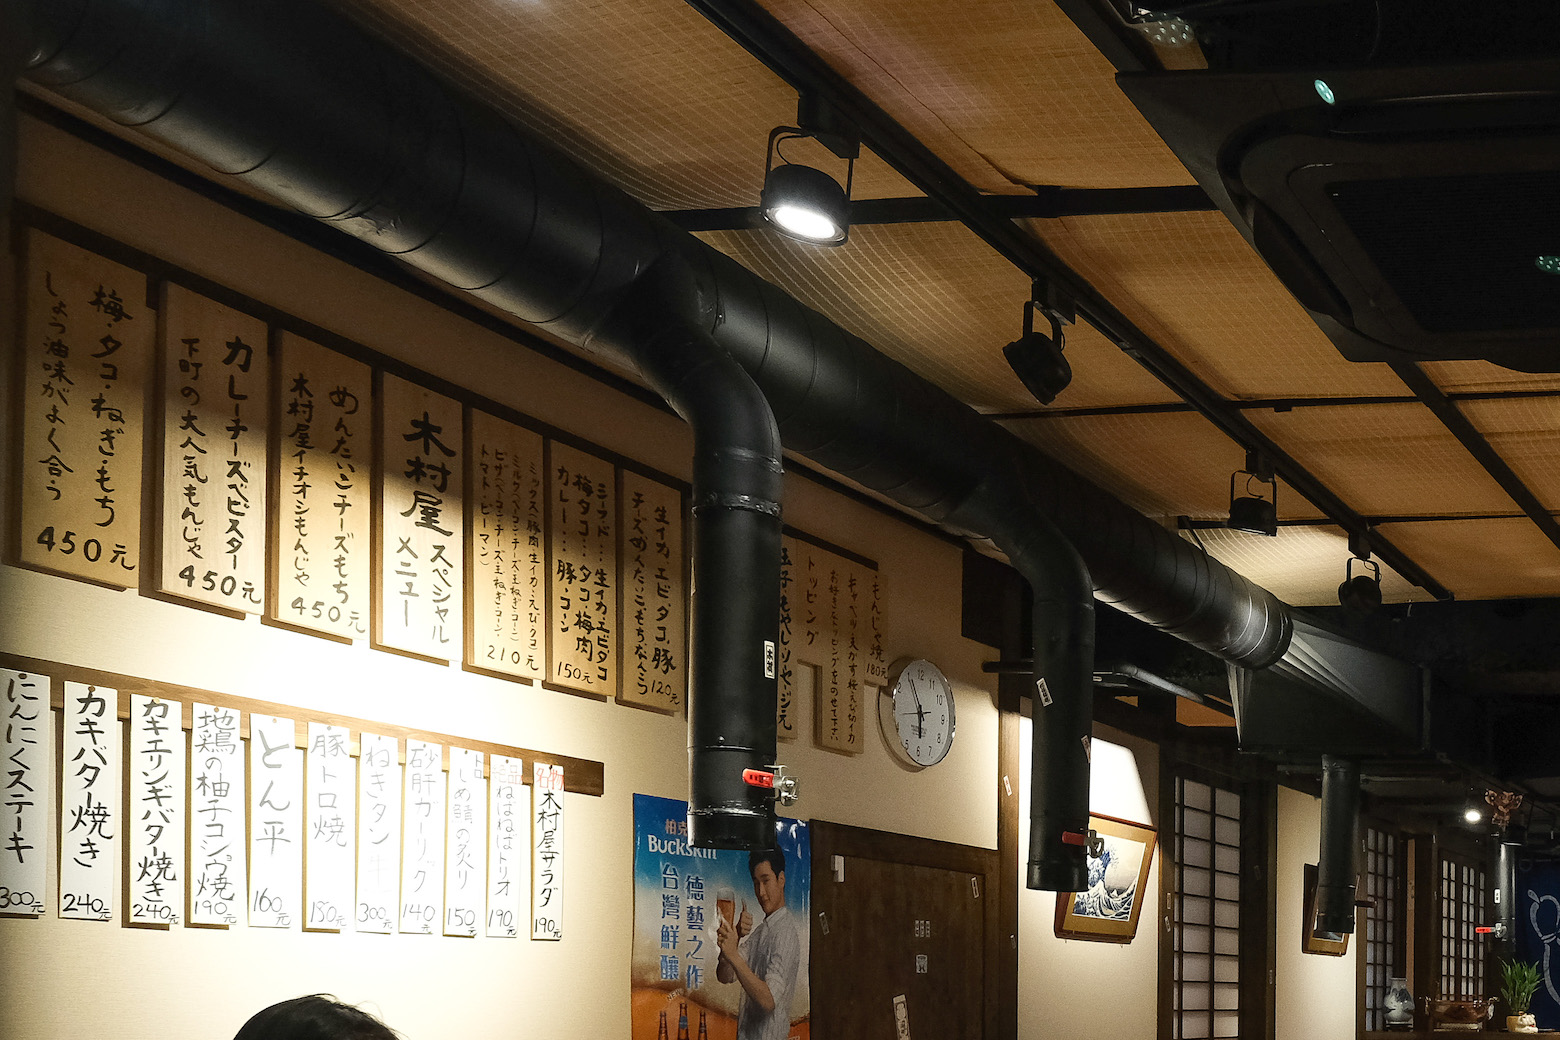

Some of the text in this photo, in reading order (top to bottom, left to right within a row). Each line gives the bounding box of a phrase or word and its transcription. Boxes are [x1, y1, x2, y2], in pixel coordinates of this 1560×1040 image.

[38, 270, 74, 500] しょう油味がよく合う
[178, 338, 208, 560] 下町の大人気もんじゃ
[287, 372, 315, 587] 木村屋イチオシもんじゃ
[328, 385, 359, 604] めんたいこチーズもち
[400, 411, 456, 644] 木村屋 スペシャル
[37, 526, 136, 571] 450元
[178, 564, 262, 604] 450元
[394, 536, 419, 627] メニュー
[290, 596, 366, 634] 450元
[806, 555, 819, 646] トッピング
[557, 661, 594, 684] 150元
[897, 681, 902, 694] 2
[917, 669, 925, 681] 12
[929, 679, 935, 690] 11
[651, 680, 680, 705] 120元
[936, 694, 943, 706] 10
[940, 714, 945, 725] 9
[916, 745, 920, 757] 6
[928, 745, 932, 756] 7
[936, 732, 942, 744] 8
[4, 678, 39, 864] にんにくステーキ
[67, 691, 115, 868] カキバター焼き
[536, 766, 564, 791] 名物
[135, 699, 177, 903] カキエリンギバター焼き
[255, 729, 292, 855] とん平
[310, 733, 348, 848] 豚トロ焼
[494, 785, 518, 897] ねばねばトリオ
[536, 789, 563, 908] 木村屋サラダ
[0, 886, 46, 914] 300元
[62, 893, 112, 920] 240元
[132, 903, 179, 926] 240元
[193, 900, 238, 924] 190元
[252, 887, 291, 926] 160元
[357, 902, 393, 930] 300元
[402, 903, 436, 934] 140元
[446, 907, 478, 938] 150元
[488, 909, 517, 937] 190元
[534, 916, 562, 939] 190元
[659, 862, 680, 980] 台灣鮮釀
[685, 874, 705, 990] 德藝之作
